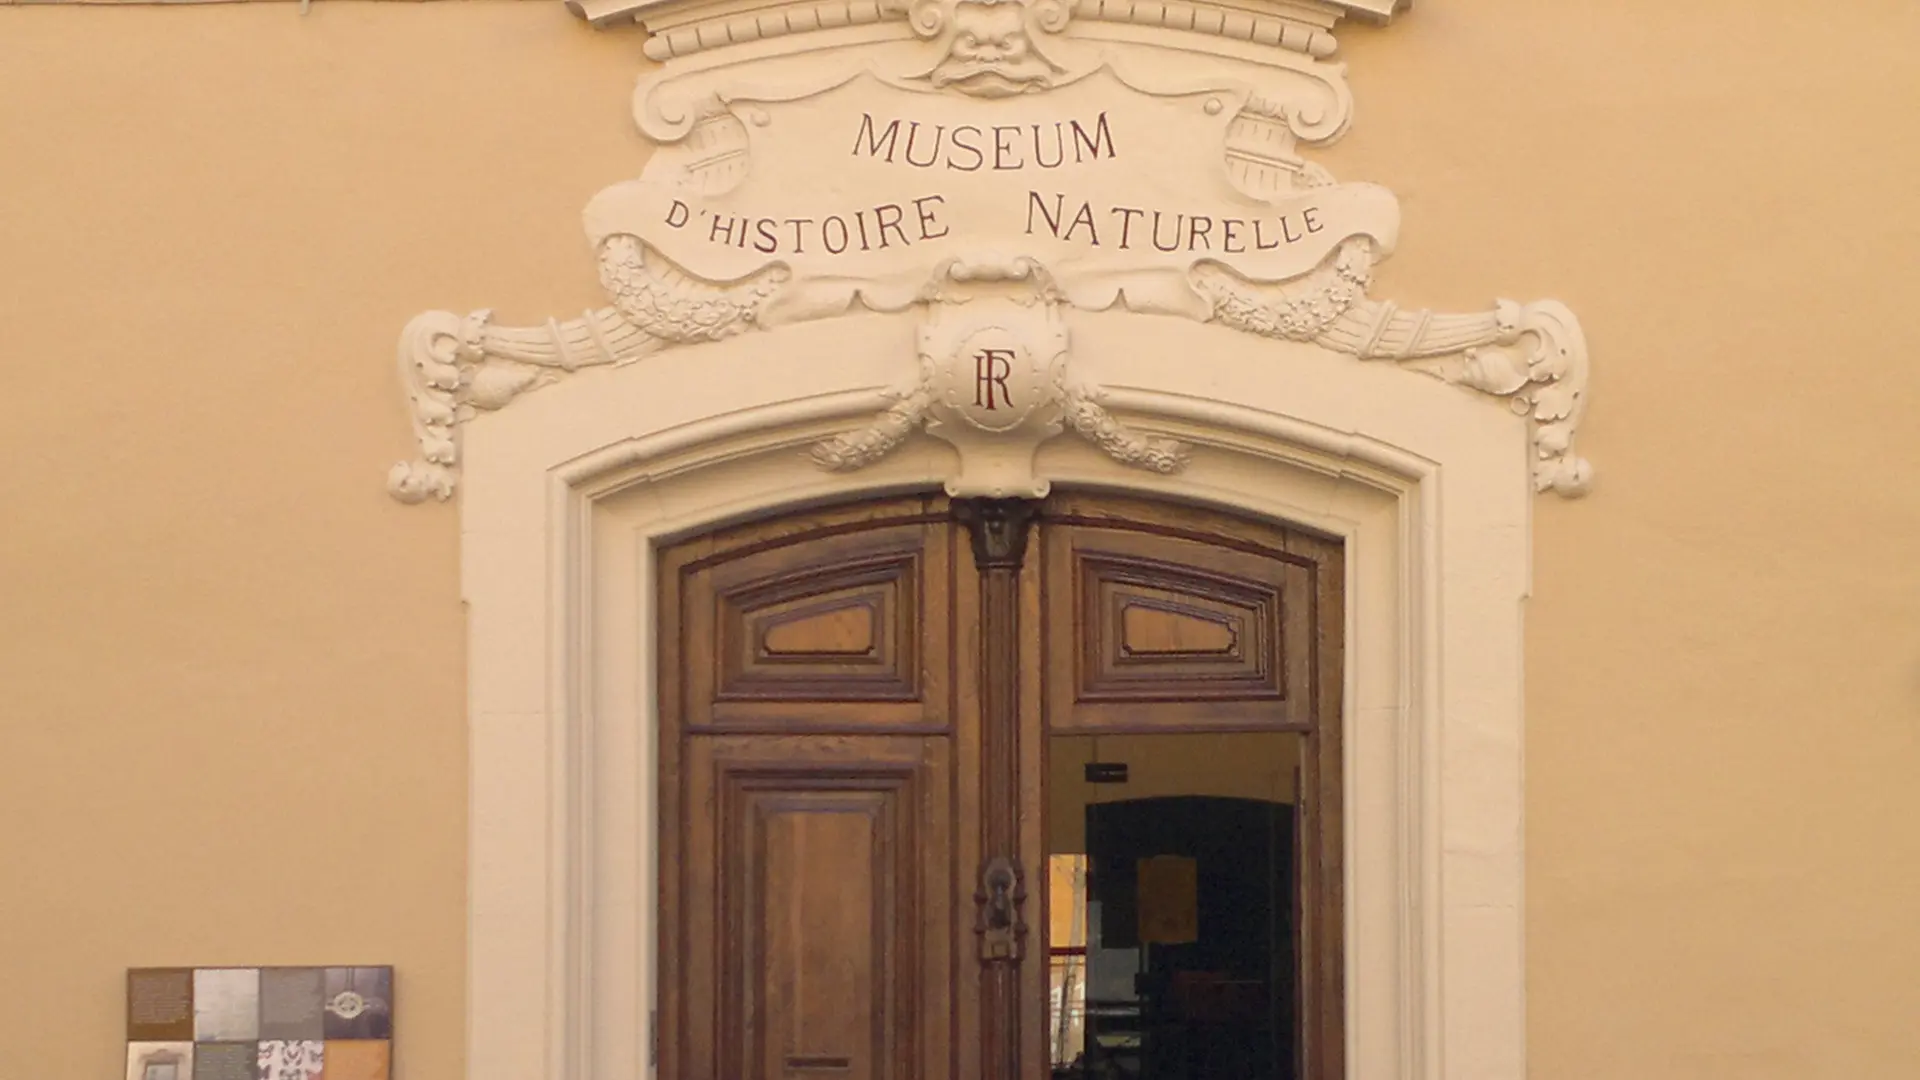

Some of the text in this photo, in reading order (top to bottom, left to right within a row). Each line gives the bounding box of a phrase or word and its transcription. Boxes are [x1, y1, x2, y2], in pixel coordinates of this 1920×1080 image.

[851, 112, 1117, 171] MUSEUM
[664, 191, 1325, 254] D'HISTOIRE NATURELLE
